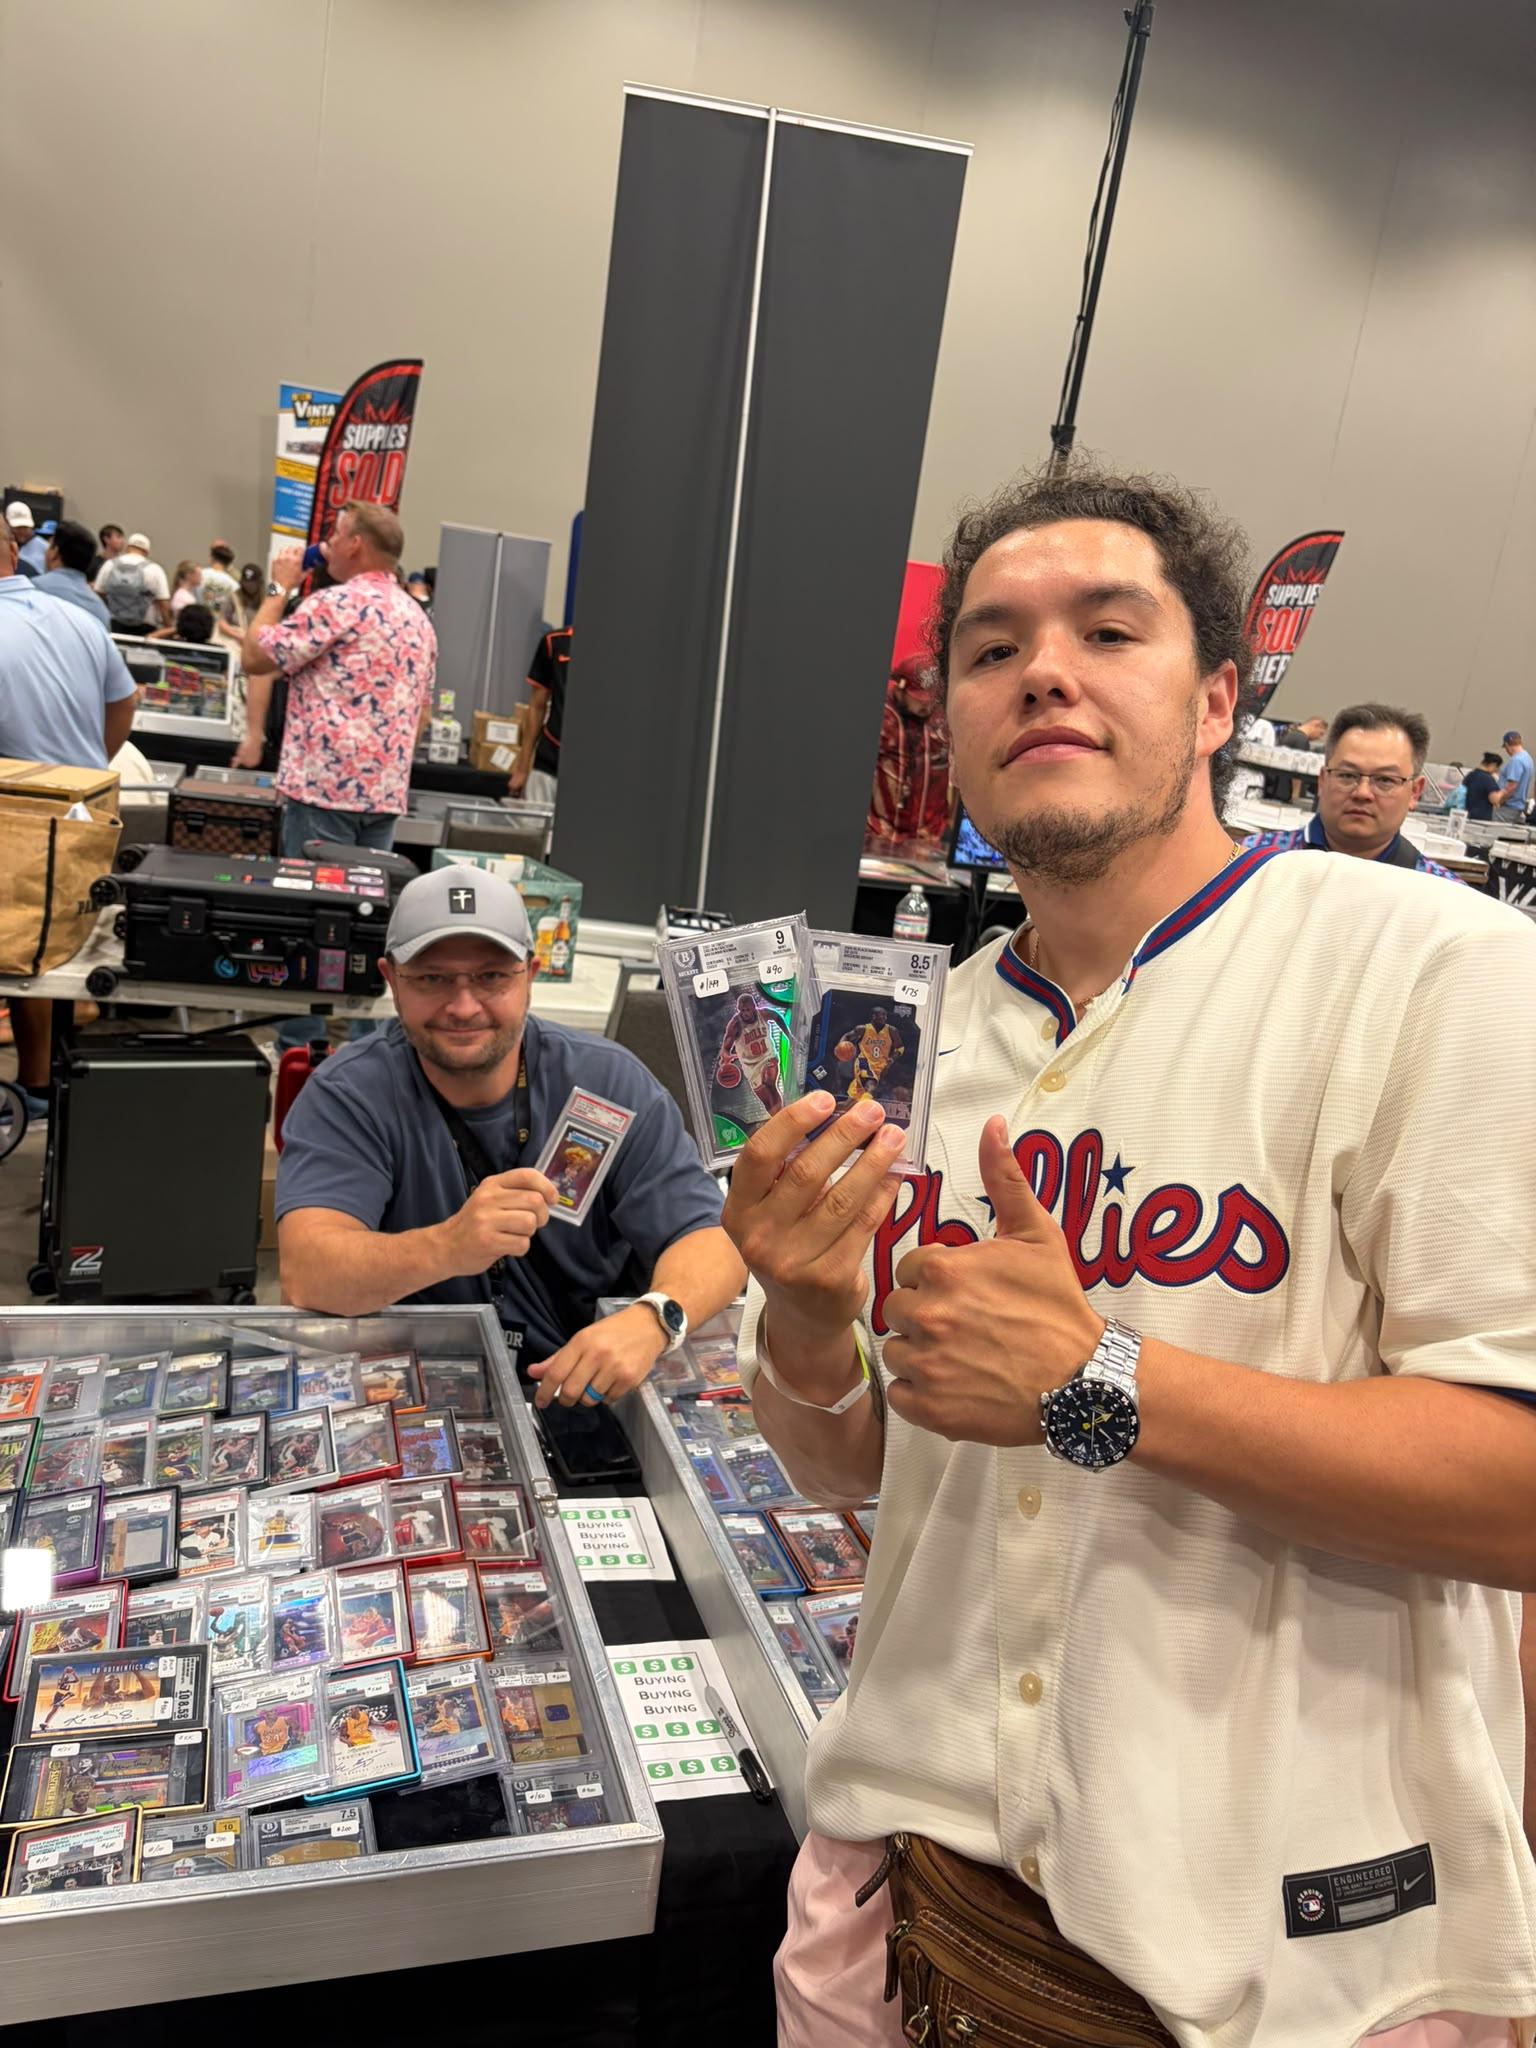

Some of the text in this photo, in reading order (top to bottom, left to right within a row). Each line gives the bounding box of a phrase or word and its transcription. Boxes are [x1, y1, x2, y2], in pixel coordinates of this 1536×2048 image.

[1265, 583, 1325, 606] SUPPLIE
[775, 930, 785, 945] 9
[910, 954, 931, 970] 8.5
[872, 1047, 881, 1058] 8
[577, 1521, 623, 1529] BUYING
[582, 1542, 630, 1550] BUYING
[634, 1674, 687, 1686] BUYING
[638, 1688, 692, 1700] BUYING
[643, 1703, 698, 1715] BUYING
[340, 1809, 357, 1819] 7.5
[193, 1823, 209, 1833] 8.5
[223, 1823, 234, 1831] 10
[1333, 1864, 1392, 1887] ENGINEERED
